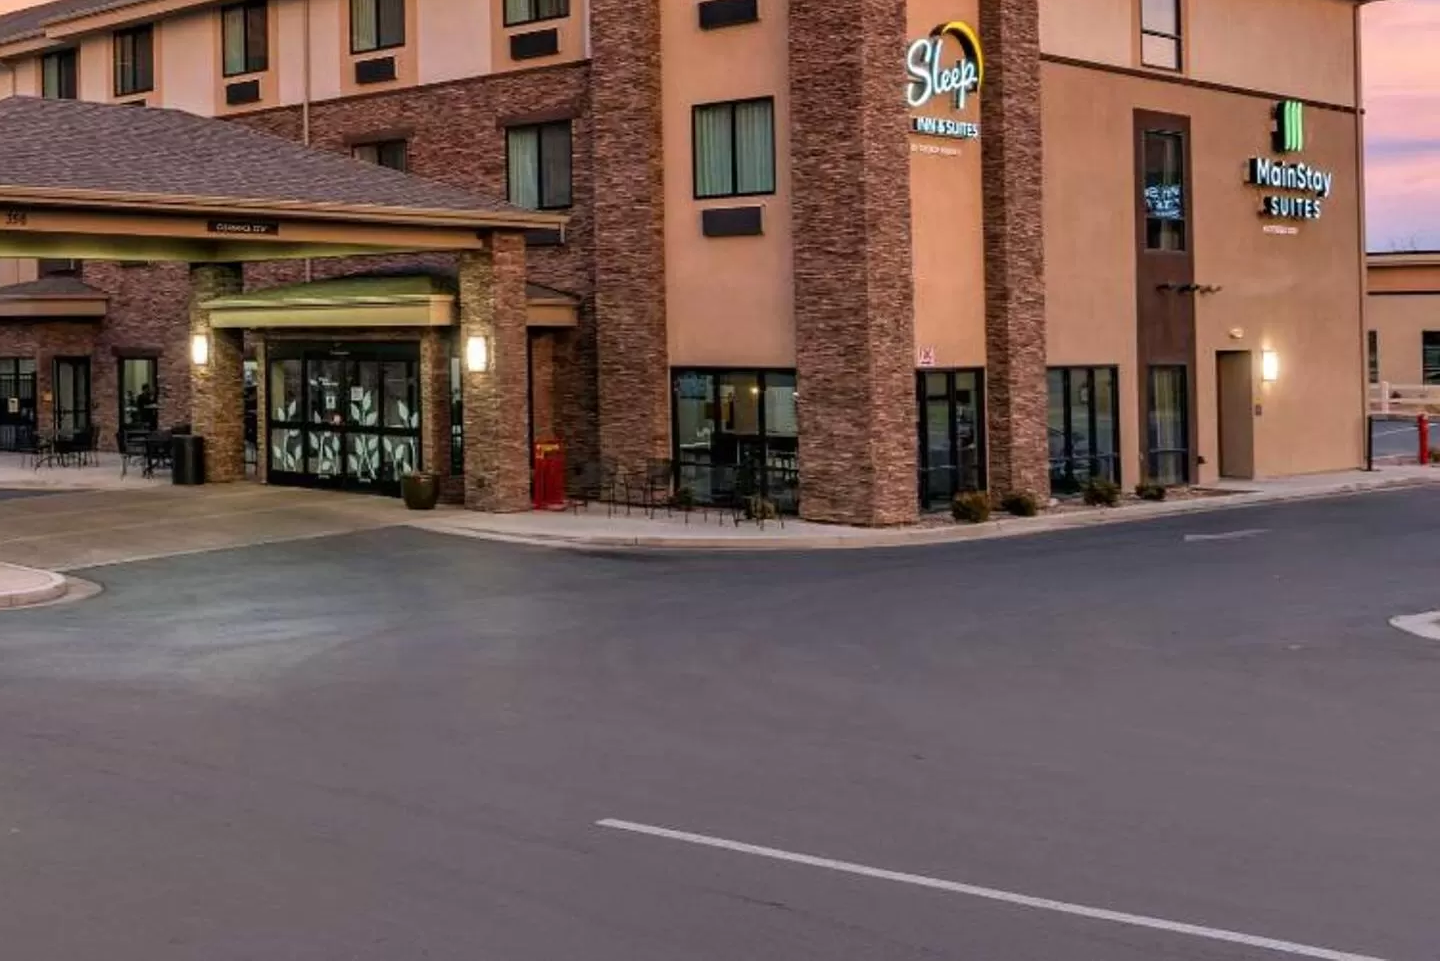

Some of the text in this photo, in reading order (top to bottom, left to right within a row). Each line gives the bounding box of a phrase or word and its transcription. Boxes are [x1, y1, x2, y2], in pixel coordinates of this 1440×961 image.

[907, 38, 978, 108] Sleep
[917, 117, 935, 133] INN
[946, 121, 978, 137] SUITES
[1257, 157, 1332, 198] MainStay
[1271, 196, 1321, 218] SUITES
